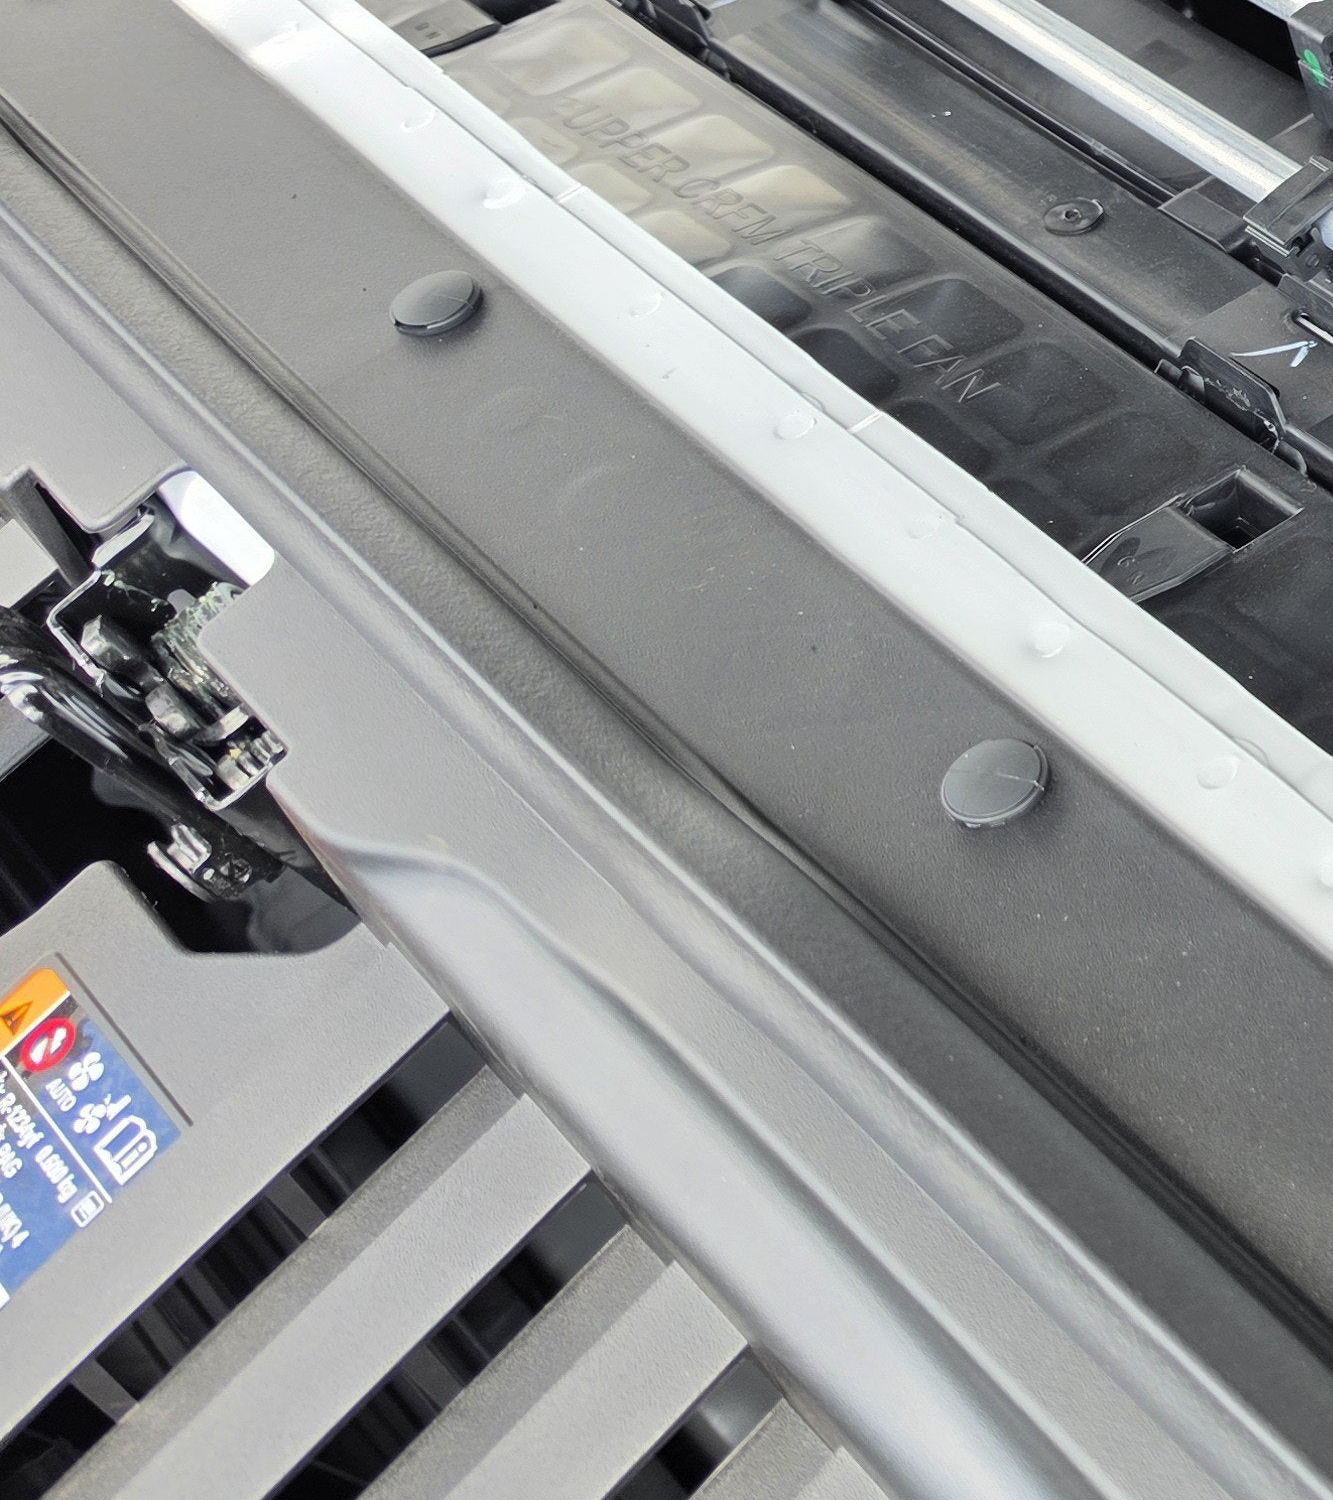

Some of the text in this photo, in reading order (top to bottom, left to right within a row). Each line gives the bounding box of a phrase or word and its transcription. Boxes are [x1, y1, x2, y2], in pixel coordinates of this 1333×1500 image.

[775, 238, 922, 341] TRIPLE
[897, 333, 1003, 403] FAN
[46, 1078, 77, 1112] AUTO
